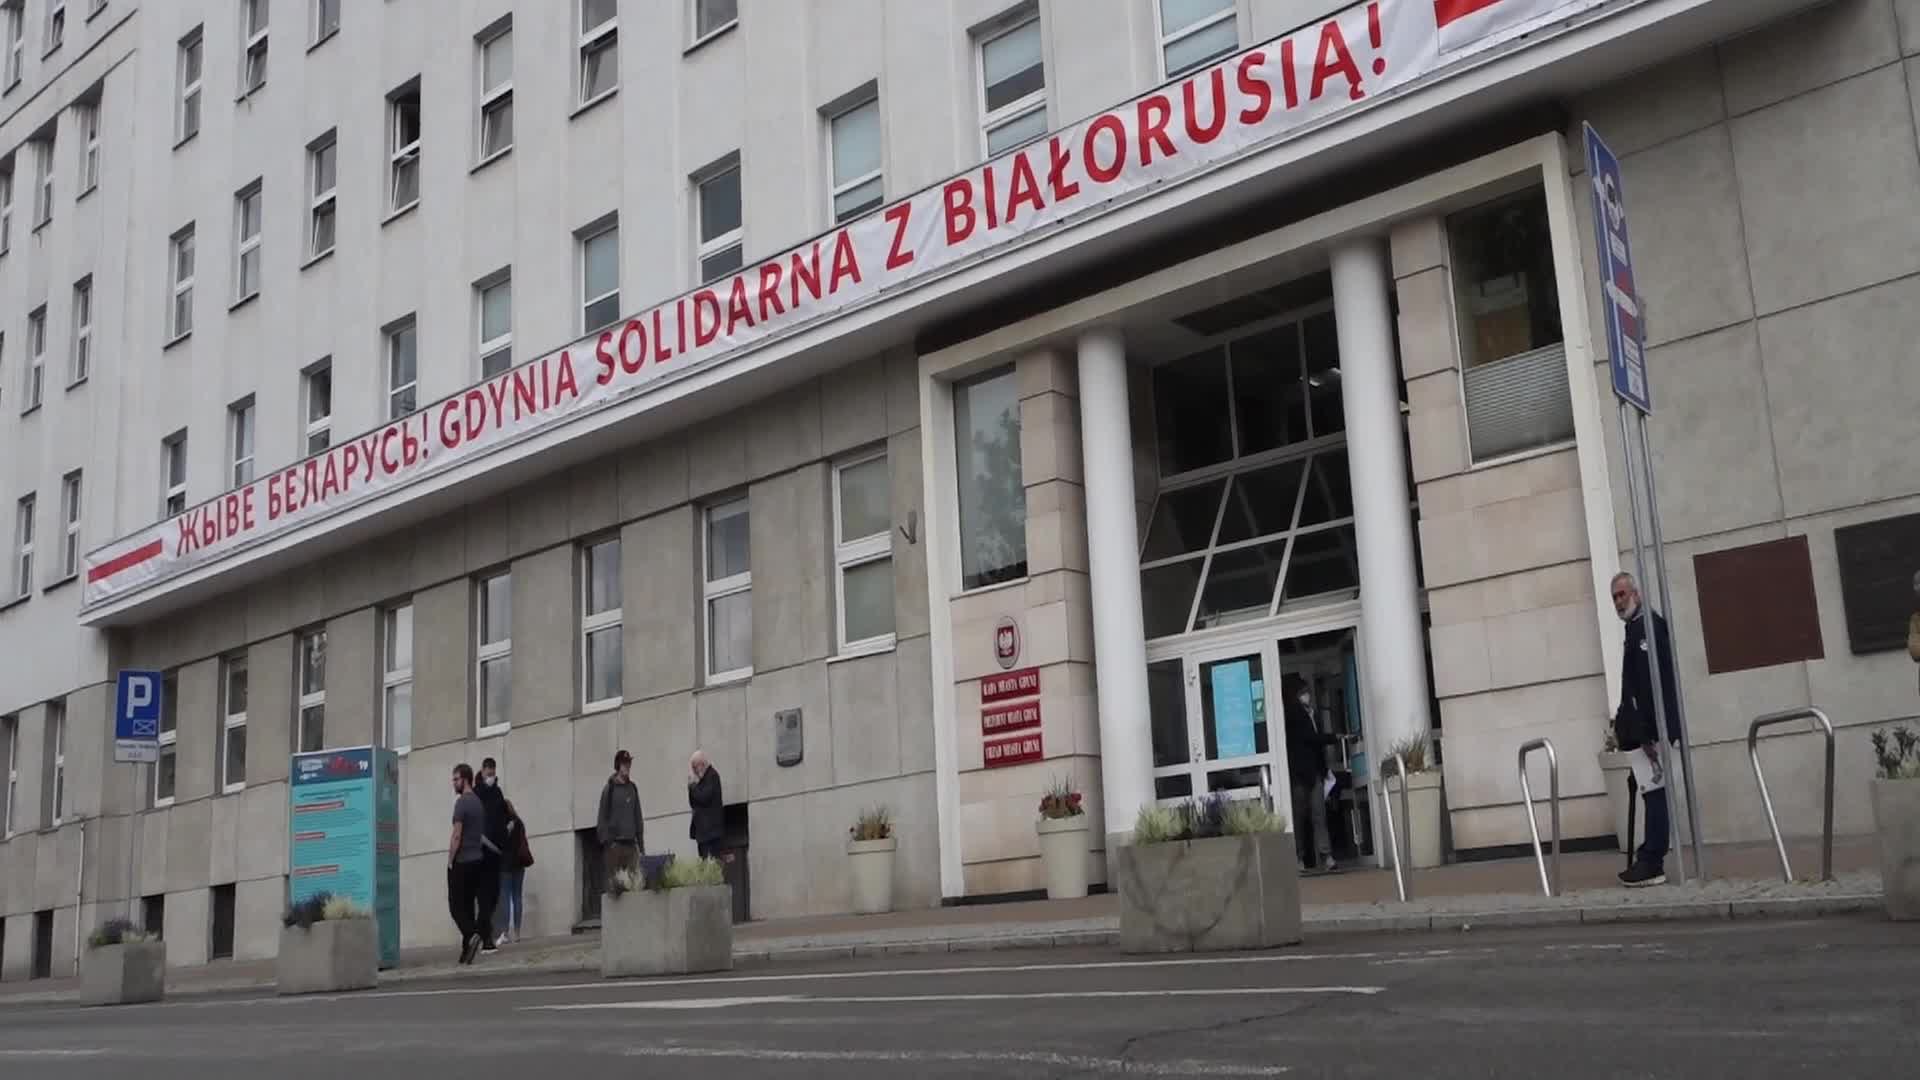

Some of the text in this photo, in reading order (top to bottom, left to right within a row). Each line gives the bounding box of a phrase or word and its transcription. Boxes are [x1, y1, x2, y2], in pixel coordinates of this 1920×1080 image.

[439, 2, 1388, 449] GDYNIA SOLIDARNA Z BIAŁORUSIĄ!
[176, 412, 429, 556] ЖЫВЕ БЕЛАРУСЬ!
[126, 676, 153, 719] P
